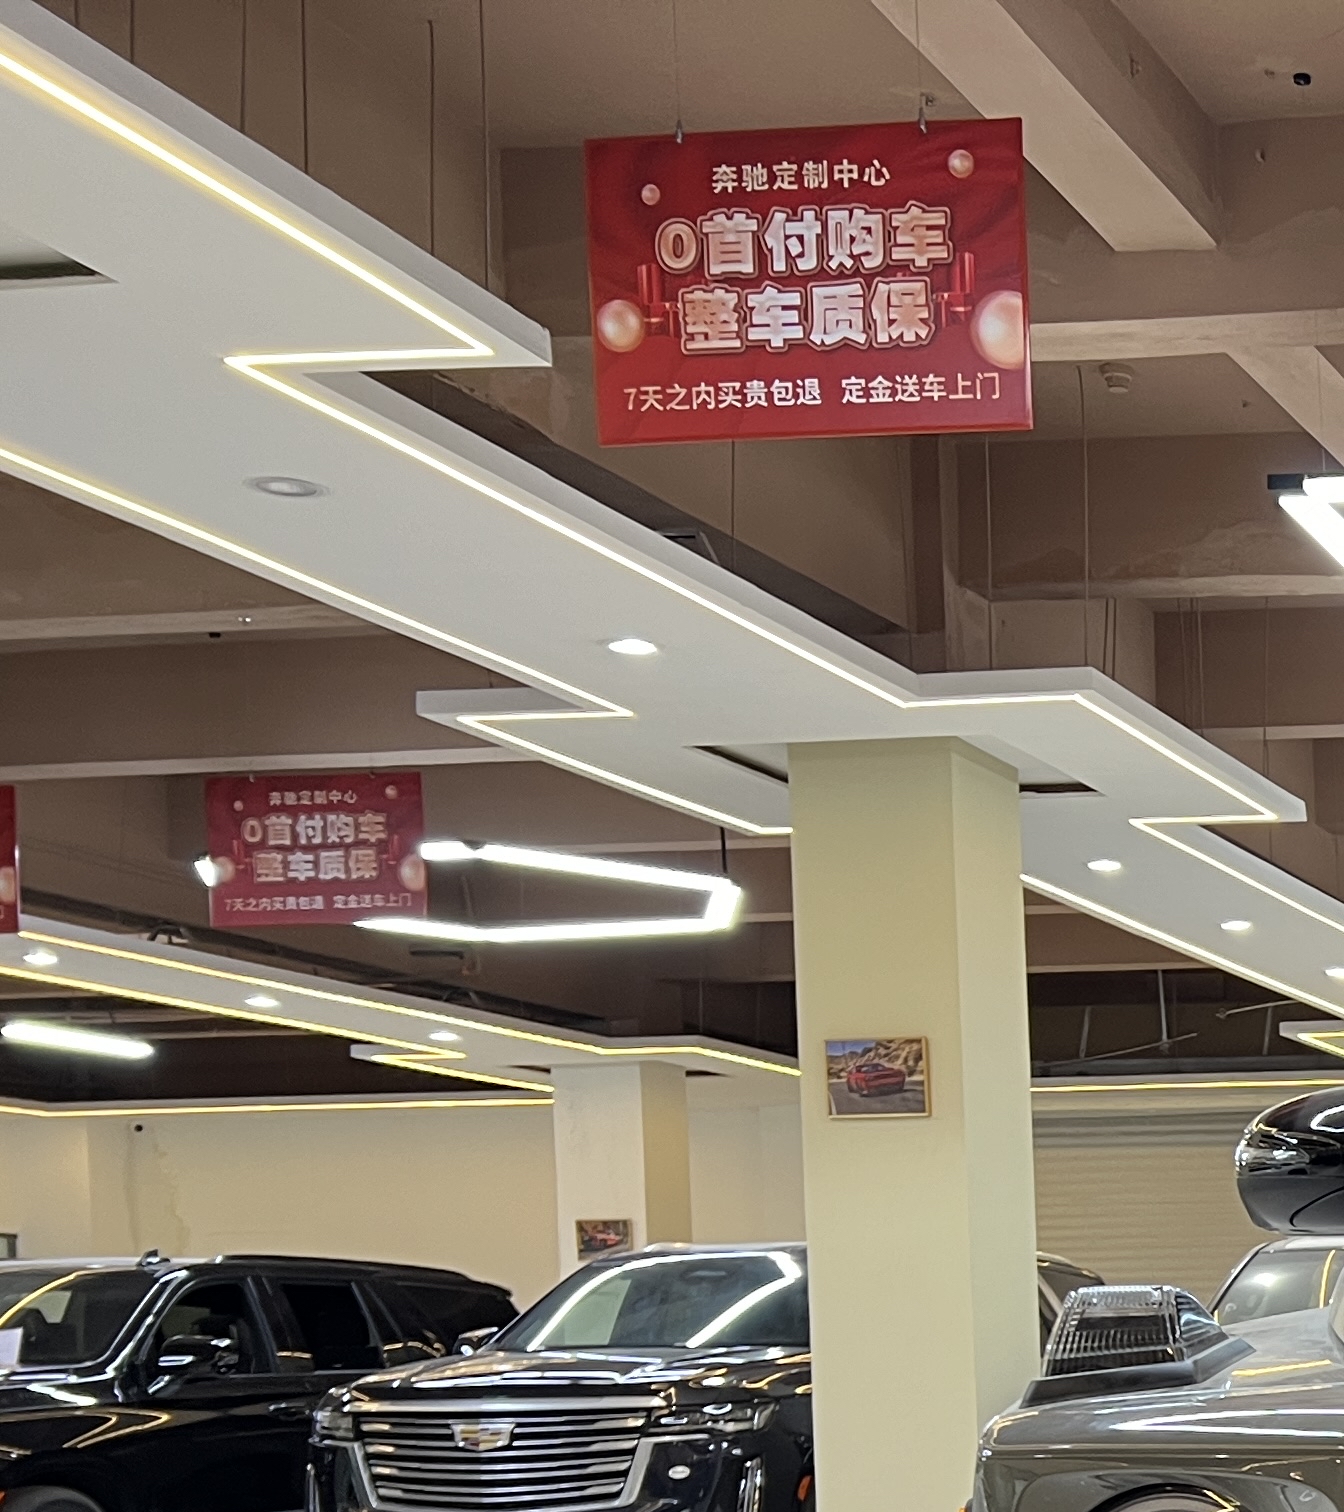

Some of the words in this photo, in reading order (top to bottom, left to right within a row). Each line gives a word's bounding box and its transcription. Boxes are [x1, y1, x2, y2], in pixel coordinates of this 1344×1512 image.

[711, 159, 891, 194] 奔驰定制中心
[656, 202, 952, 276] 0首付购车
[681, 279, 933, 352] 整车质保
[623, 377, 822, 413] 7天之内买贵包退
[841, 371, 1001, 405] 定金送车上门
[242, 812, 388, 846] 0首付购车
[255, 849, 379, 883] 整车质保
